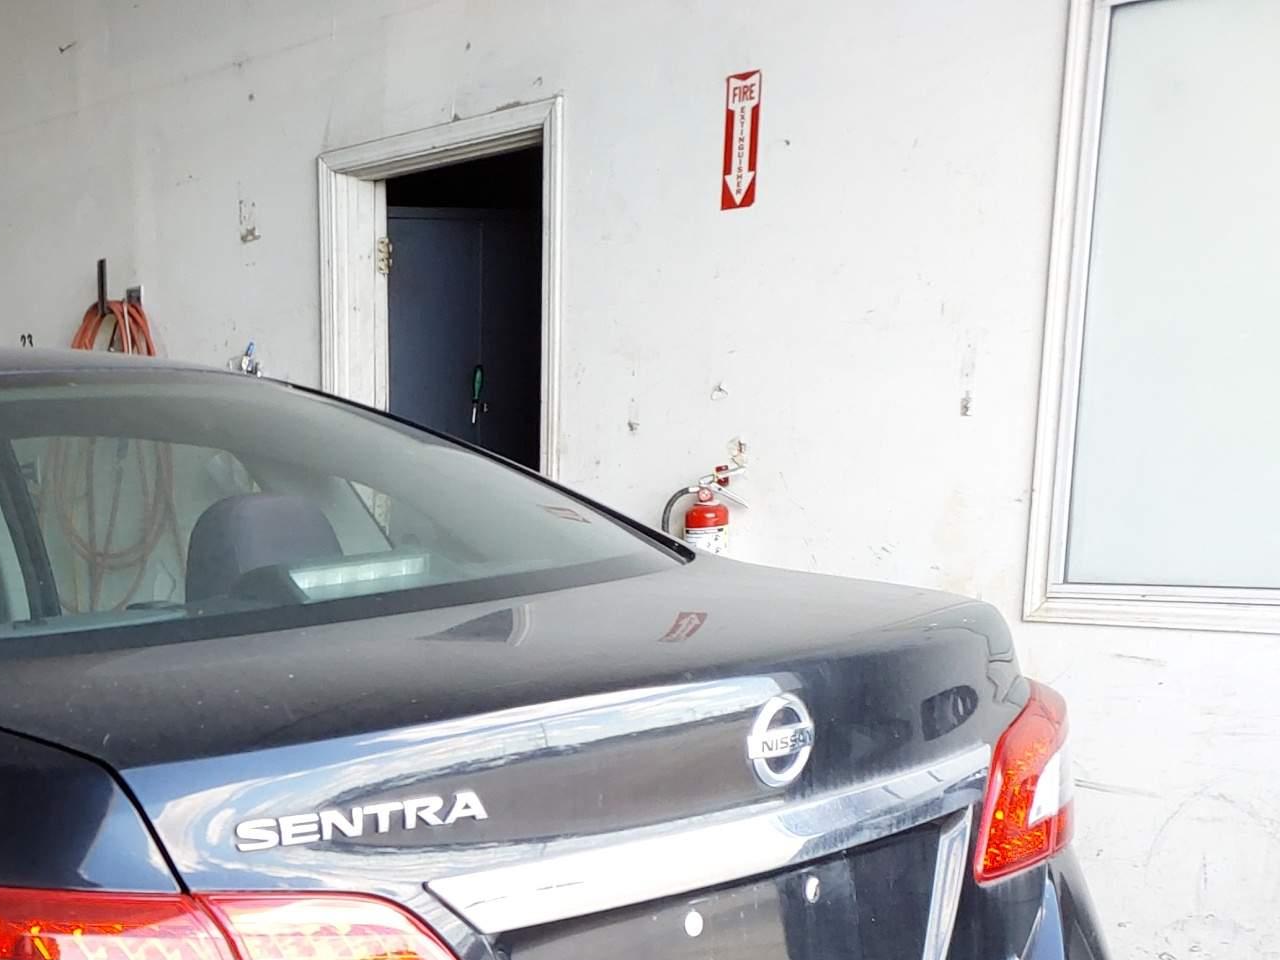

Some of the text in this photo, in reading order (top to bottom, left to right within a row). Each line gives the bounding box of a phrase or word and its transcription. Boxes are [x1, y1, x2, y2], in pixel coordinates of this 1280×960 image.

[732, 83, 756, 104] FIRE
[735, 106, 746, 196] EXTINGUISHER
[761, 727, 814, 753] NISSAN
[235, 790, 489, 852] SENTRA
